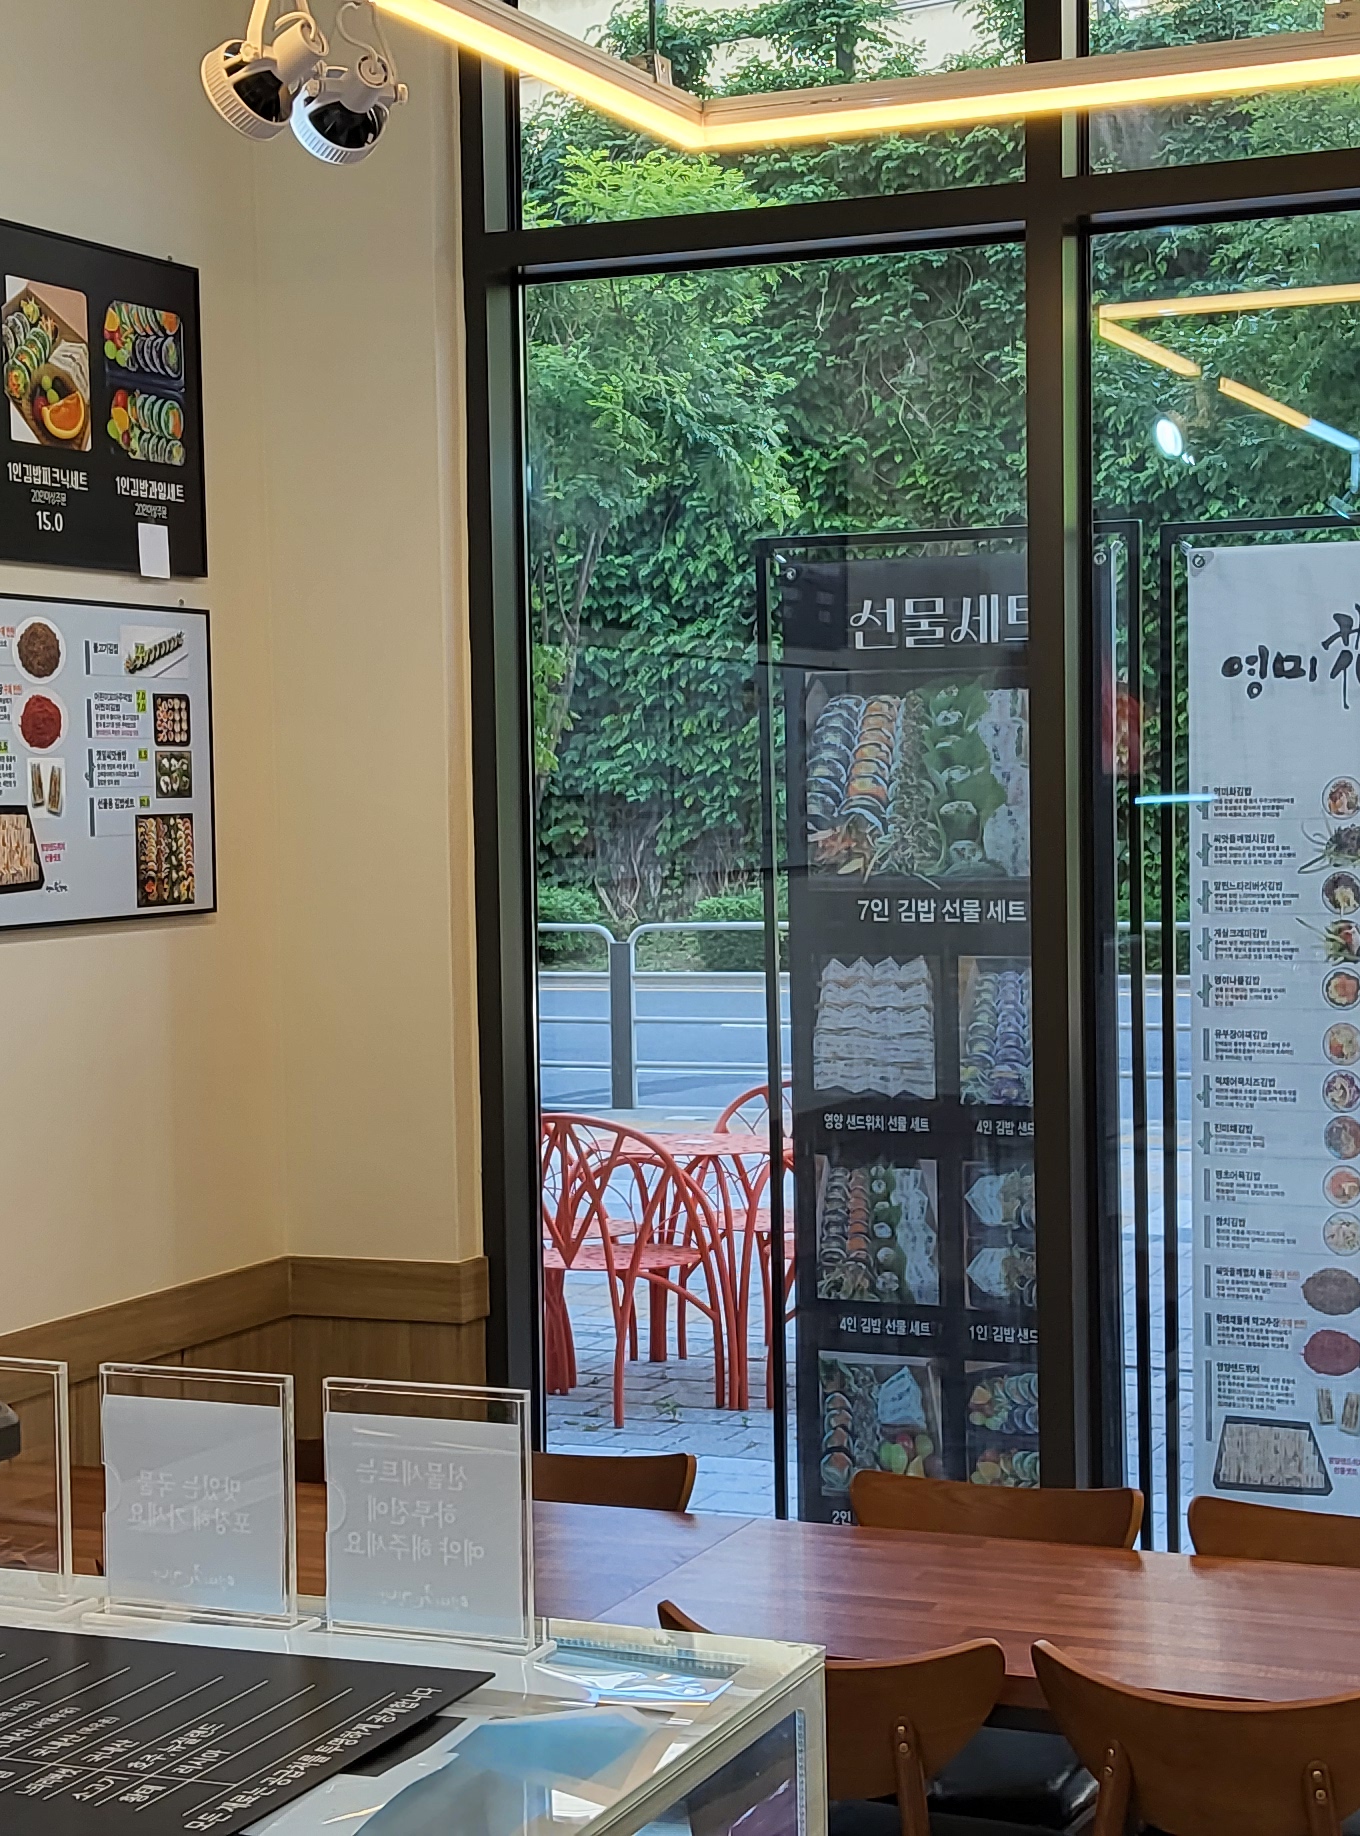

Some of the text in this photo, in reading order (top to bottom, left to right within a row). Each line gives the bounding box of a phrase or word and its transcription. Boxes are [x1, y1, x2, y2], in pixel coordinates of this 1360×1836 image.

[36, 511, 64, 532] 15.0
[857, 899, 1027, 923] 7인 김밥 선물 세트
[996, 1120, 1014, 1135] 김밥
[840, 1317, 931, 1336] 4인 김밥 선물 세트
[969, 1326, 988, 1341] 1인
[993, 1327, 1015, 1342] 김밥
[28, 1735, 86, 1756] 국내산
[81, 1740, 139, 1762] 국내산
[184, 1688, 442, 1830] 모든 재료는 공급처를 투명하게 공개합니다
[120, 1750, 230, 1802] 황태 러시아
[73, 1776, 128, 1800] 소고기
